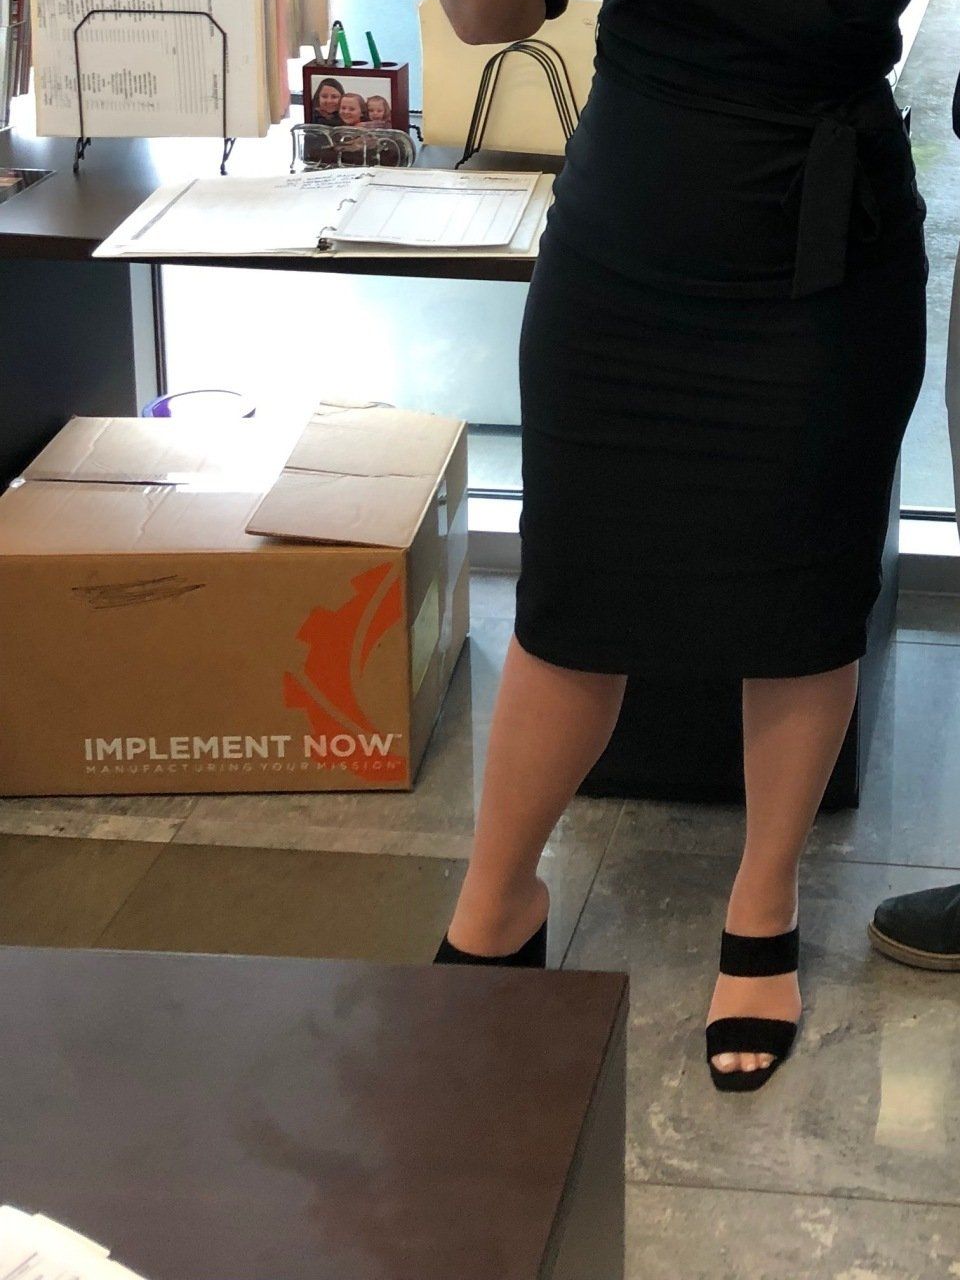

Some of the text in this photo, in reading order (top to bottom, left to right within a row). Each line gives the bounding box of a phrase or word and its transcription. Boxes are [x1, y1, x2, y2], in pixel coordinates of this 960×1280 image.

[84, 735, 291, 761] IMPLEMENT
[86, 762, 252, 774] MANUFACTURING
[260, 761, 310, 772] YOUR
